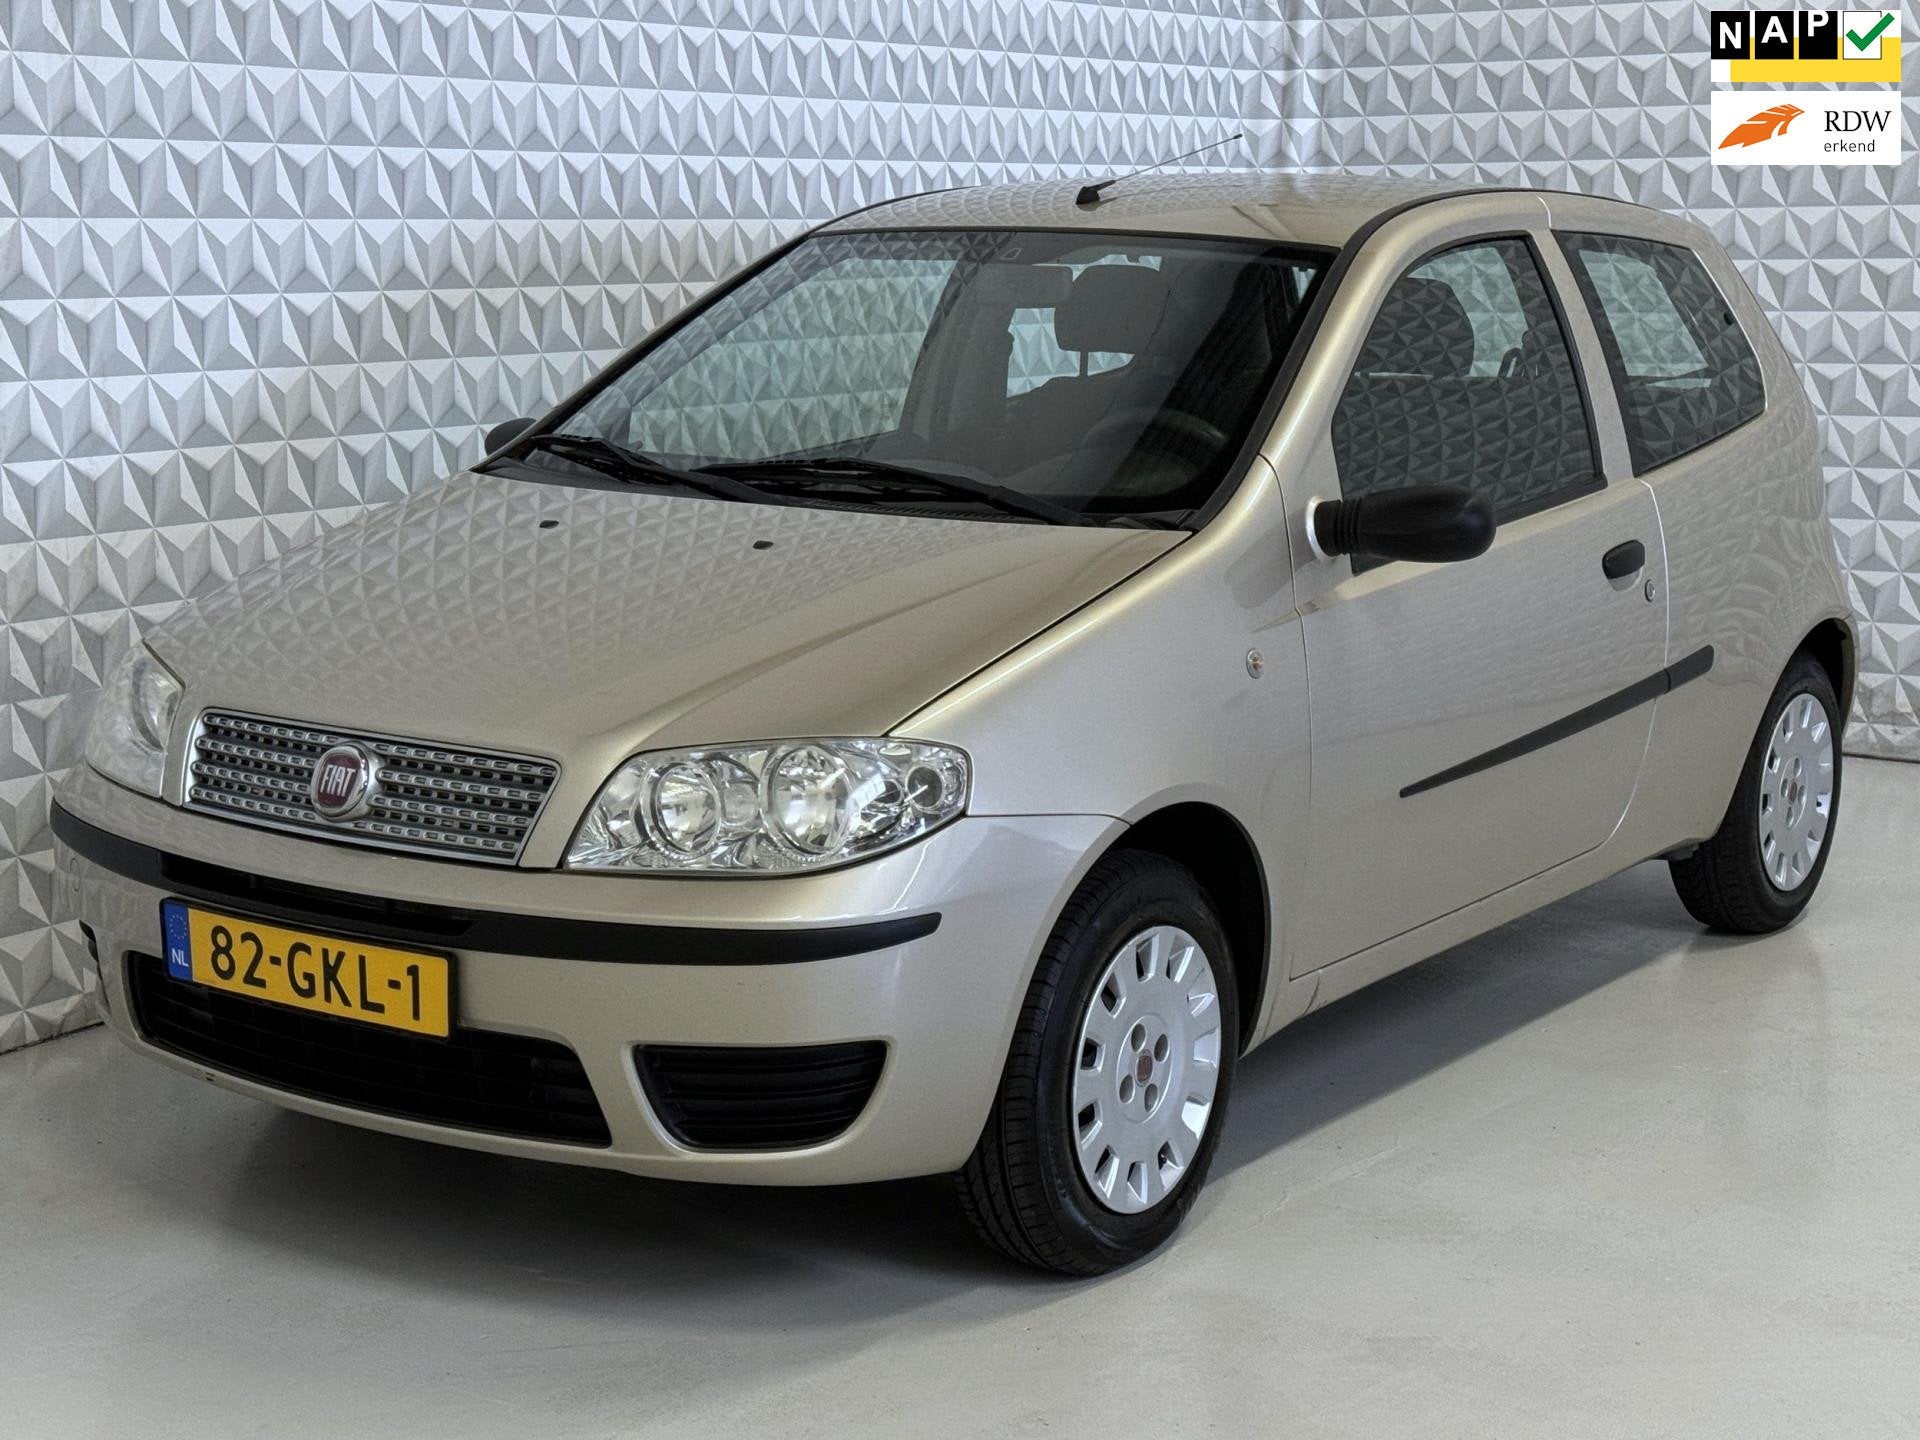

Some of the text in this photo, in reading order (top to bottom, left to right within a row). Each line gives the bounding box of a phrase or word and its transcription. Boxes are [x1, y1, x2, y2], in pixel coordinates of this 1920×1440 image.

[320, 764, 356, 797] FIAT
[171, 948, 190, 968] NL
[210, 925, 421, 1021] 82-GKL-1
